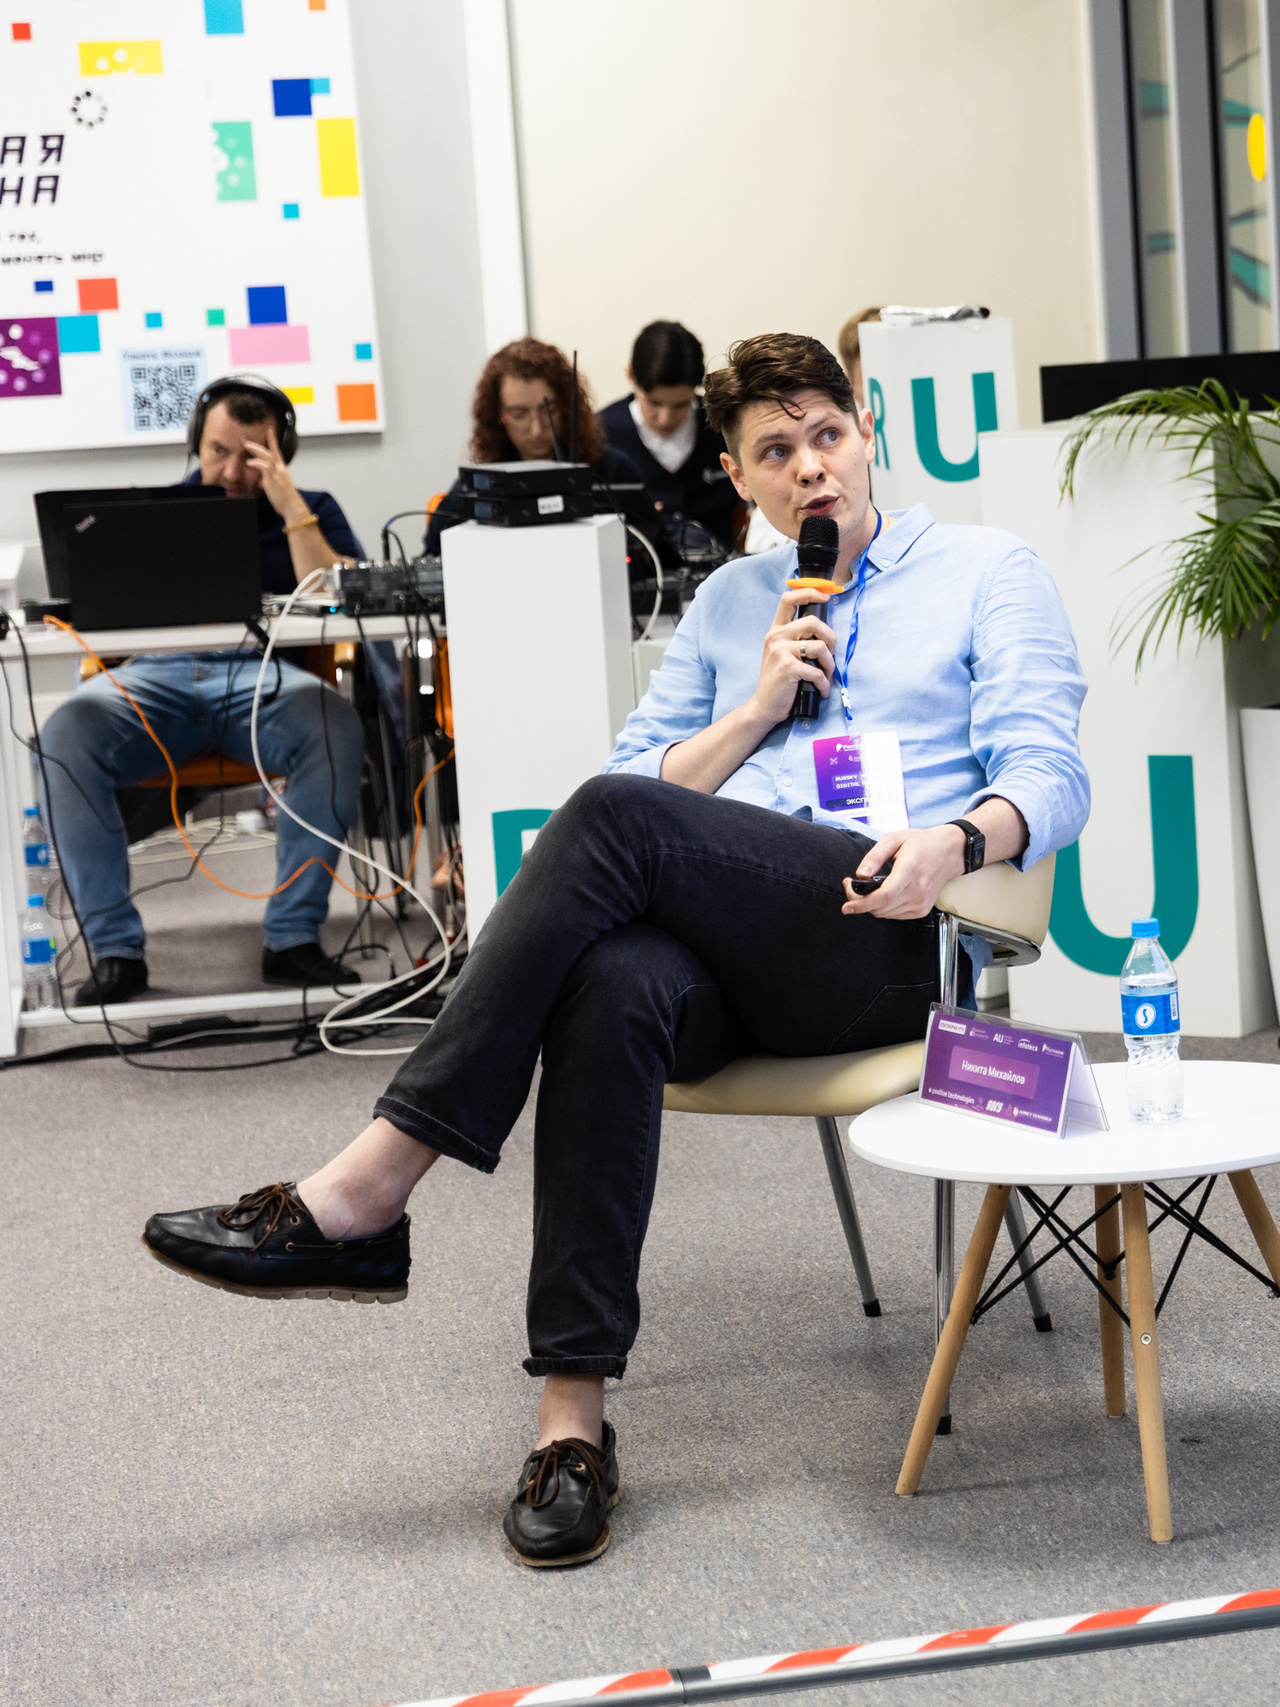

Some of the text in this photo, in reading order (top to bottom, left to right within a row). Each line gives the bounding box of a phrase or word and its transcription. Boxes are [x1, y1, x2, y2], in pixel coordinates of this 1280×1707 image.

[1017, 1040, 1038, 1052] infotecs
[962, 1060, 1026, 1085] Никита Михайлов
[931, 1088, 975, 1105] positive technologies
